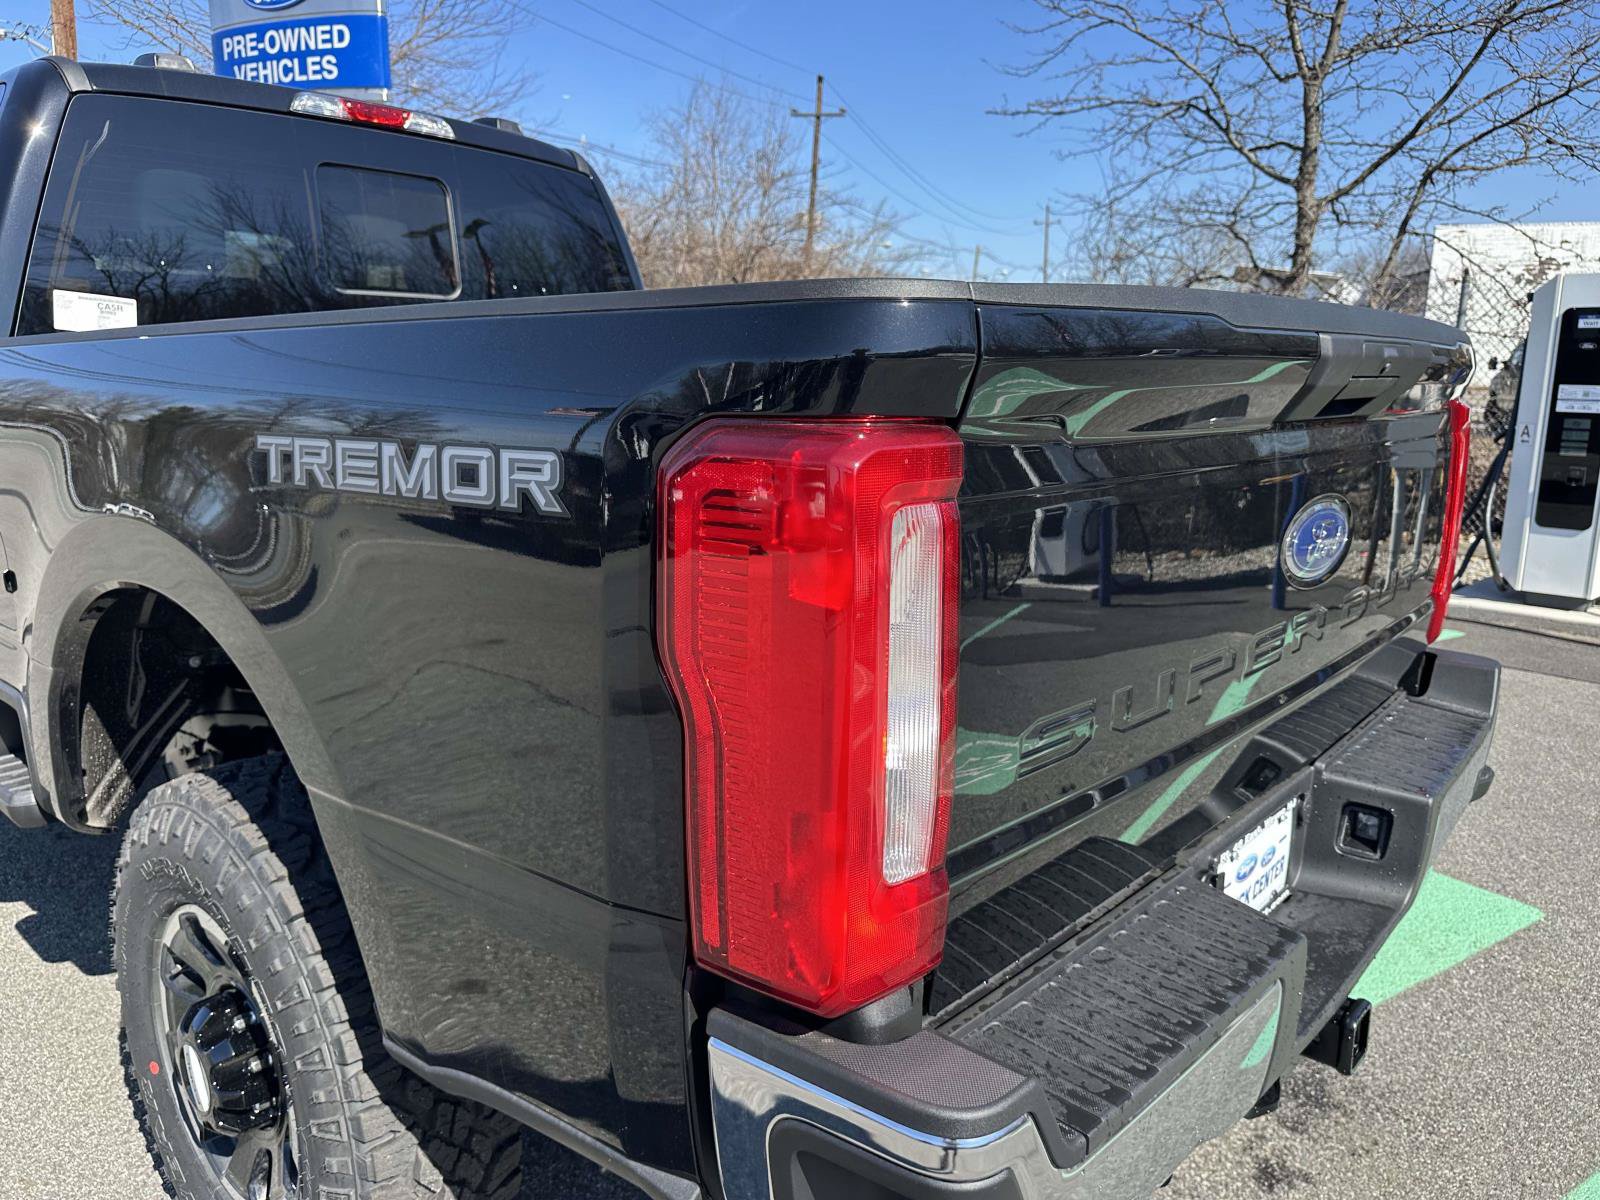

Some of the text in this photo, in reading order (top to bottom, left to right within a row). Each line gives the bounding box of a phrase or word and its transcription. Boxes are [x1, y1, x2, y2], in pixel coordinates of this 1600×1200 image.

[222, 24, 350, 61] PRE-OWNED
[233, 55, 339, 85] VEHICLES
[1520, 424, 1530, 437] A
[255, 433, 568, 516] TREMOR
[1017, 602, 1328, 781] SUPER
[1252, 855, 1285, 899] CENTER
